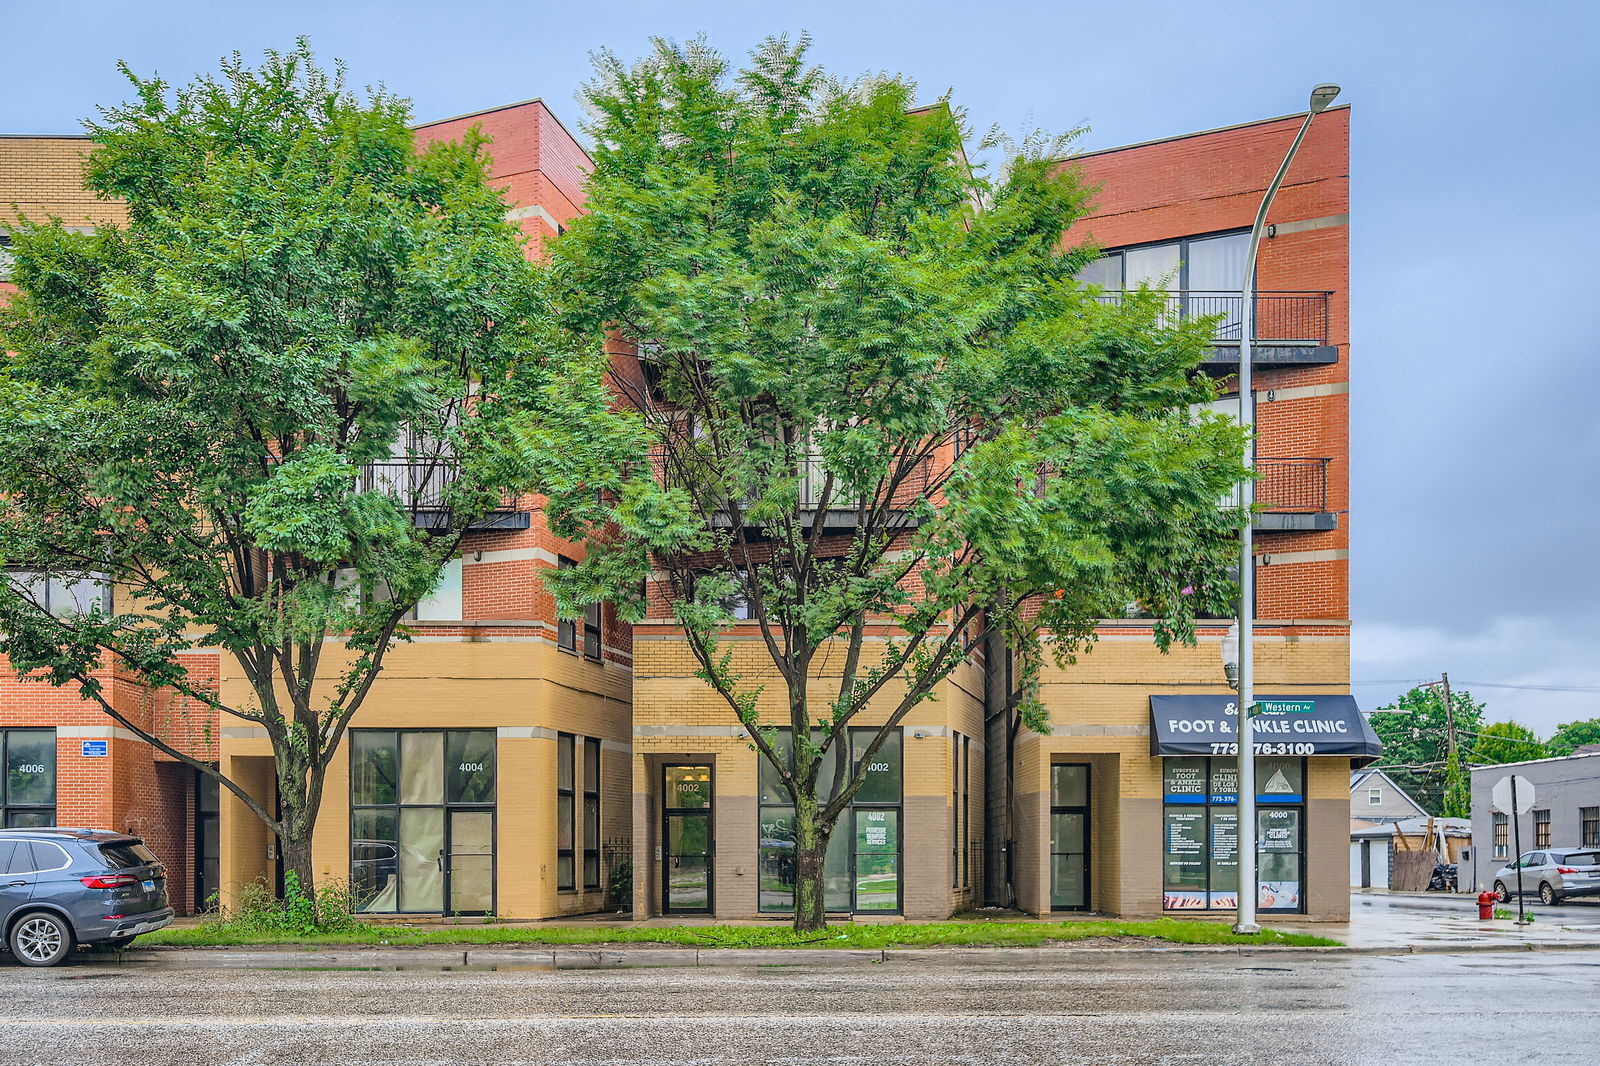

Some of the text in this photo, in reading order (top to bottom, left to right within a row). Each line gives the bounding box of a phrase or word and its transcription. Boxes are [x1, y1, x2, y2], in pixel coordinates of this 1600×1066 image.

[1265, 702, 1300, 712] Western
[1168, 719, 1347, 733] FOOT & NKLE CLINIC
[1210, 743, 1315, 755] 77376-3100
[19, 764, 44, 773] 4006
[459, 762, 484, 772] 4004
[676, 783, 700, 792] 4002
[1170, 785, 1201, 793] CLINIC
[868, 811, 885, 821] 4002
[1269, 811, 1288, 819] 4000
